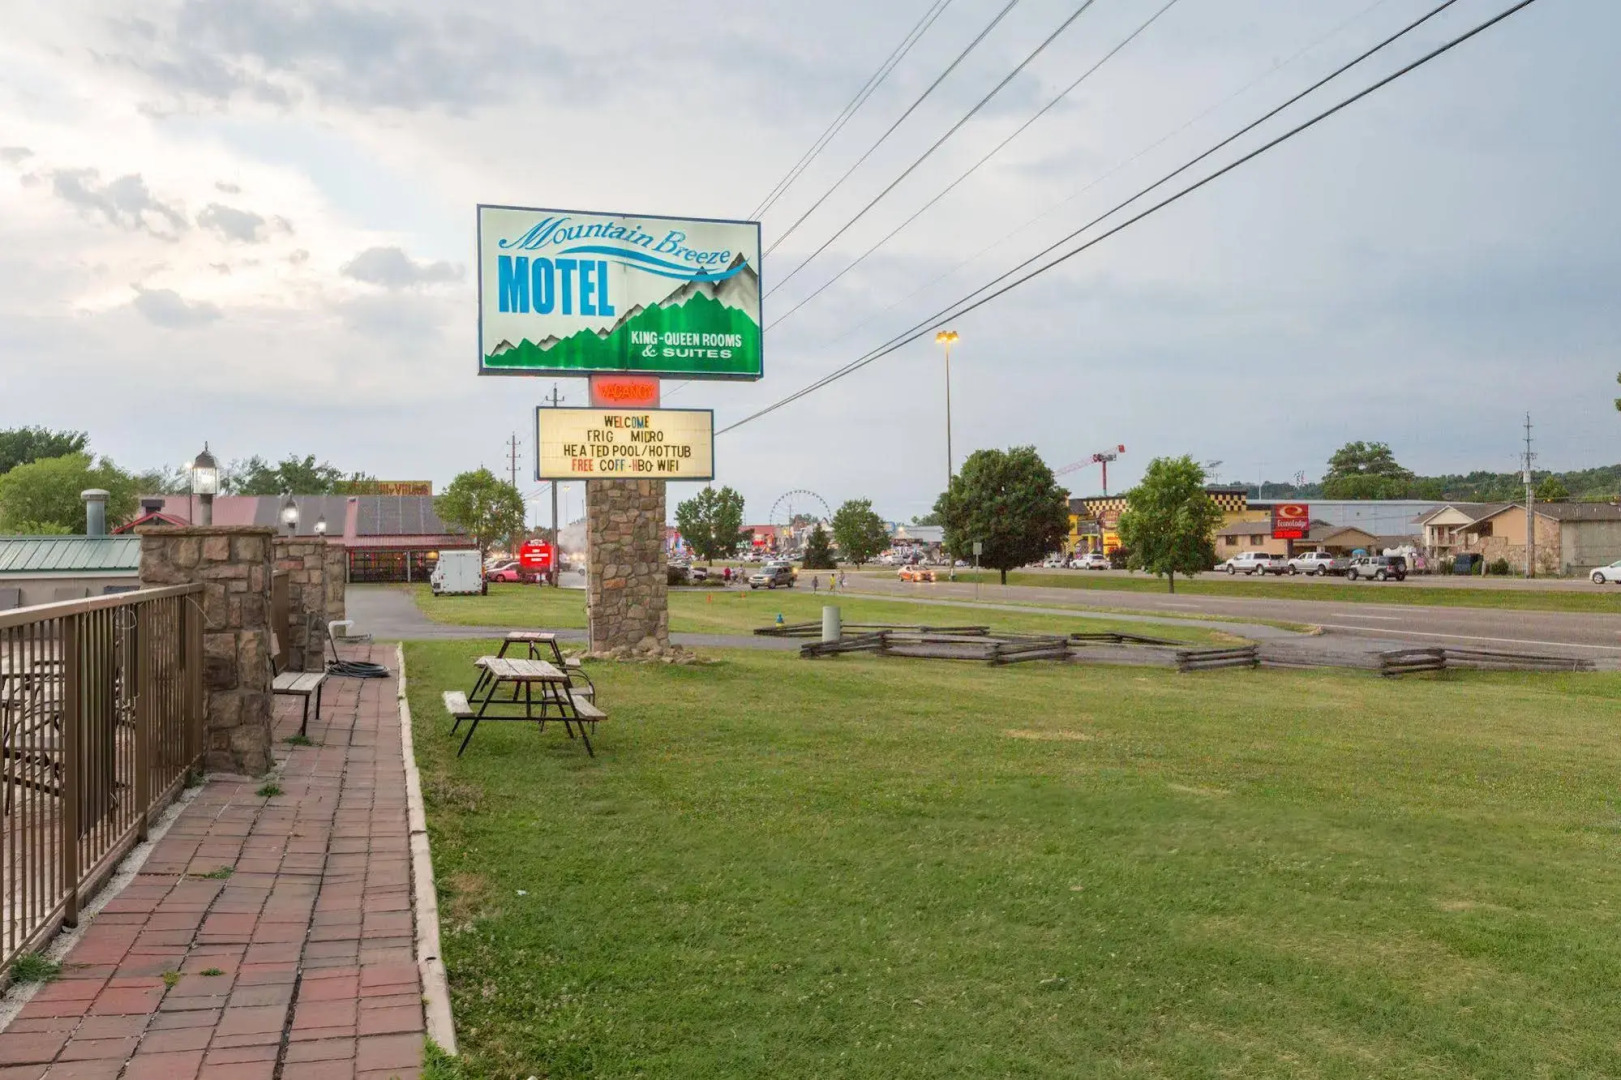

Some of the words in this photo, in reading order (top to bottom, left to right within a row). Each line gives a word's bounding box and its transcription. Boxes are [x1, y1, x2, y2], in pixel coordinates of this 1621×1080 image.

[498, 216, 654, 250] Mountain
[651, 229, 731, 264] Breeze
[497, 255, 615, 316] MOTEL
[631, 330, 700, 346] KING-QUEEN
[702, 333, 742, 347] ROOMS
[641, 344, 658, 357] &
[662, 347, 732, 358] SUITES
[604, 415, 650, 428] WELCOME
[571, 459, 594, 472] FREE
[599, 459, 625, 472] COFF
[657, 460, 679, 472] WIFI
